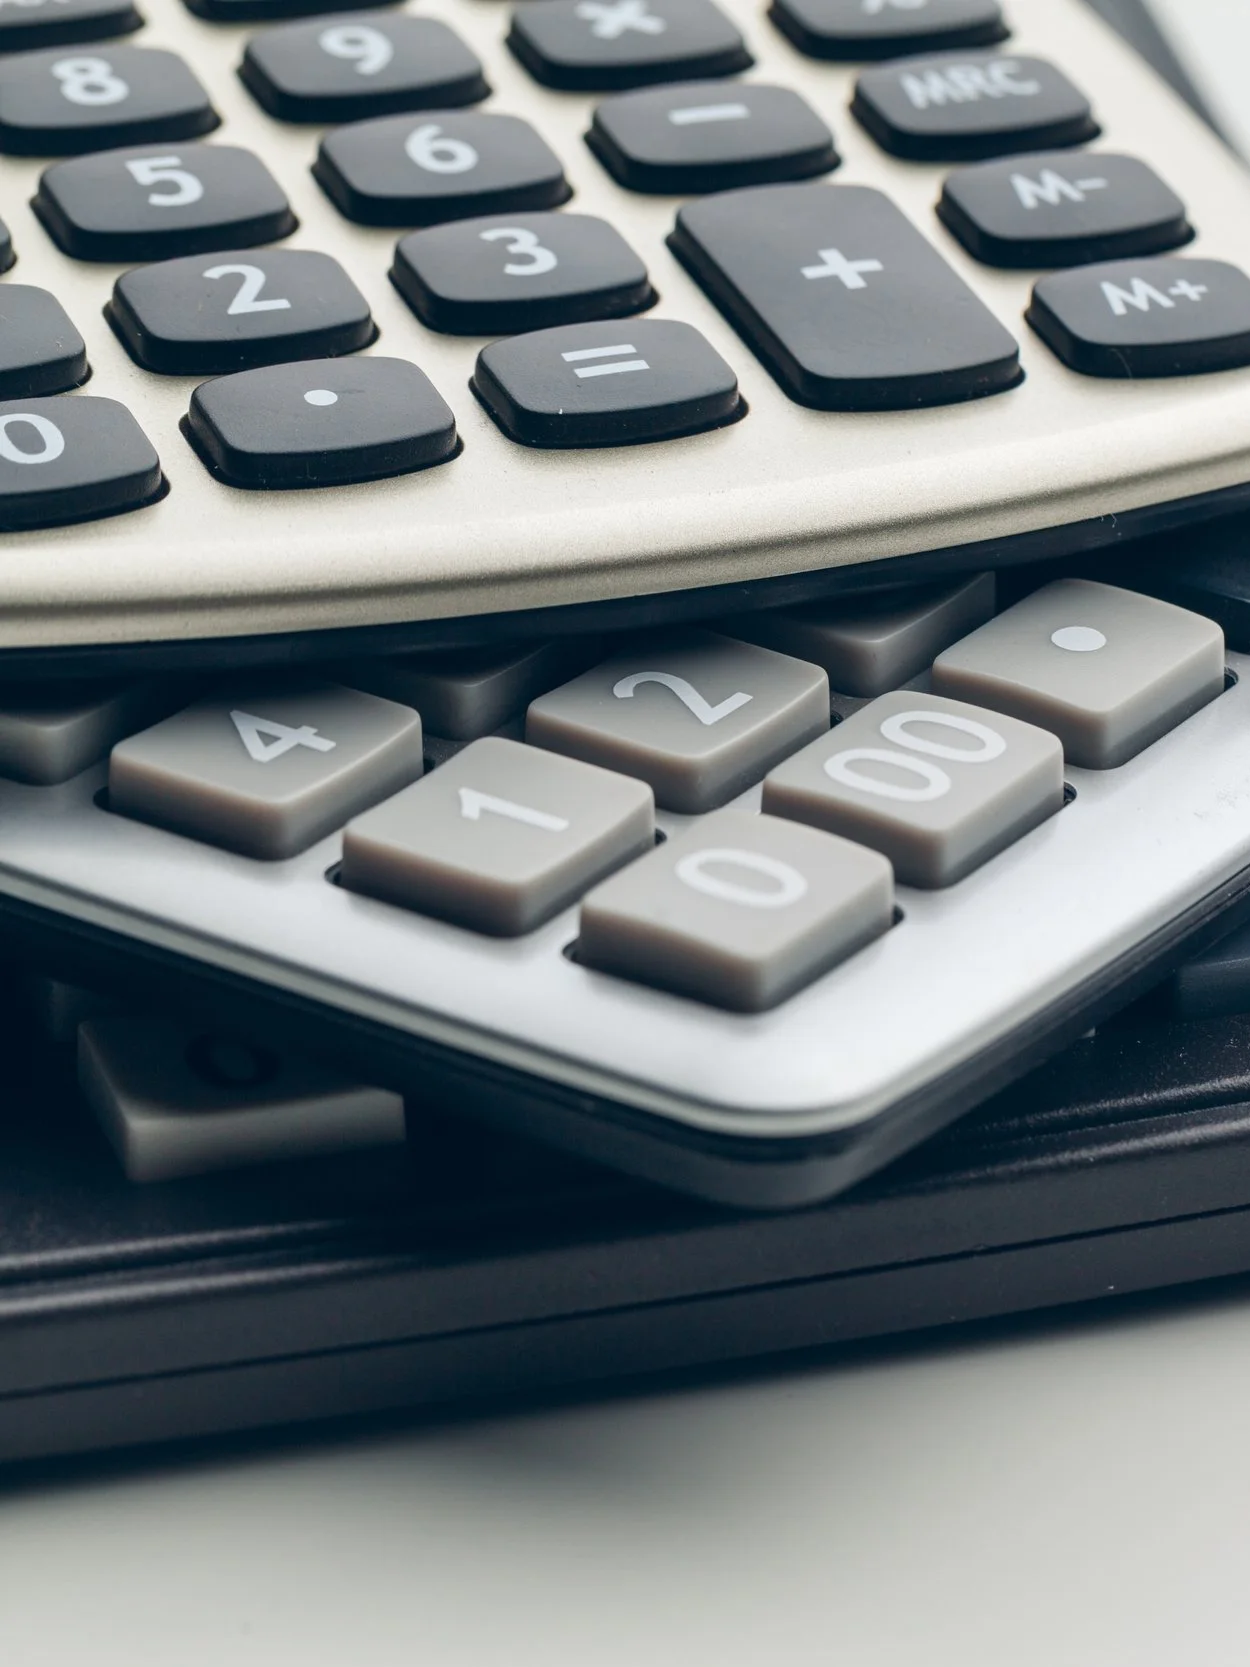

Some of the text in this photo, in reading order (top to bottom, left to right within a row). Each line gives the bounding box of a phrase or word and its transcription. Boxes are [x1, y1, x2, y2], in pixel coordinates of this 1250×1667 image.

[319, 25, 393, 74] 9
[52, 57, 129, 105] 8
[900, 59, 1041, 109] MRC
[405, 124, 477, 173] 6
[125, 155, 203, 206] 5
[1011, 169, 1108, 210] M-
[479, 227, 558, 276] 3
[202, 264, 292, 315] 2
[1100, 277, 1208, 316] M+
[0, 413, 65, 465] 0
[612, 671, 754, 726] 2
[230, 709, 336, 764] 4
[823, 710, 1007, 802] 00
[457, 786, 570, 833] 1
[675, 848, 808, 908] 0
